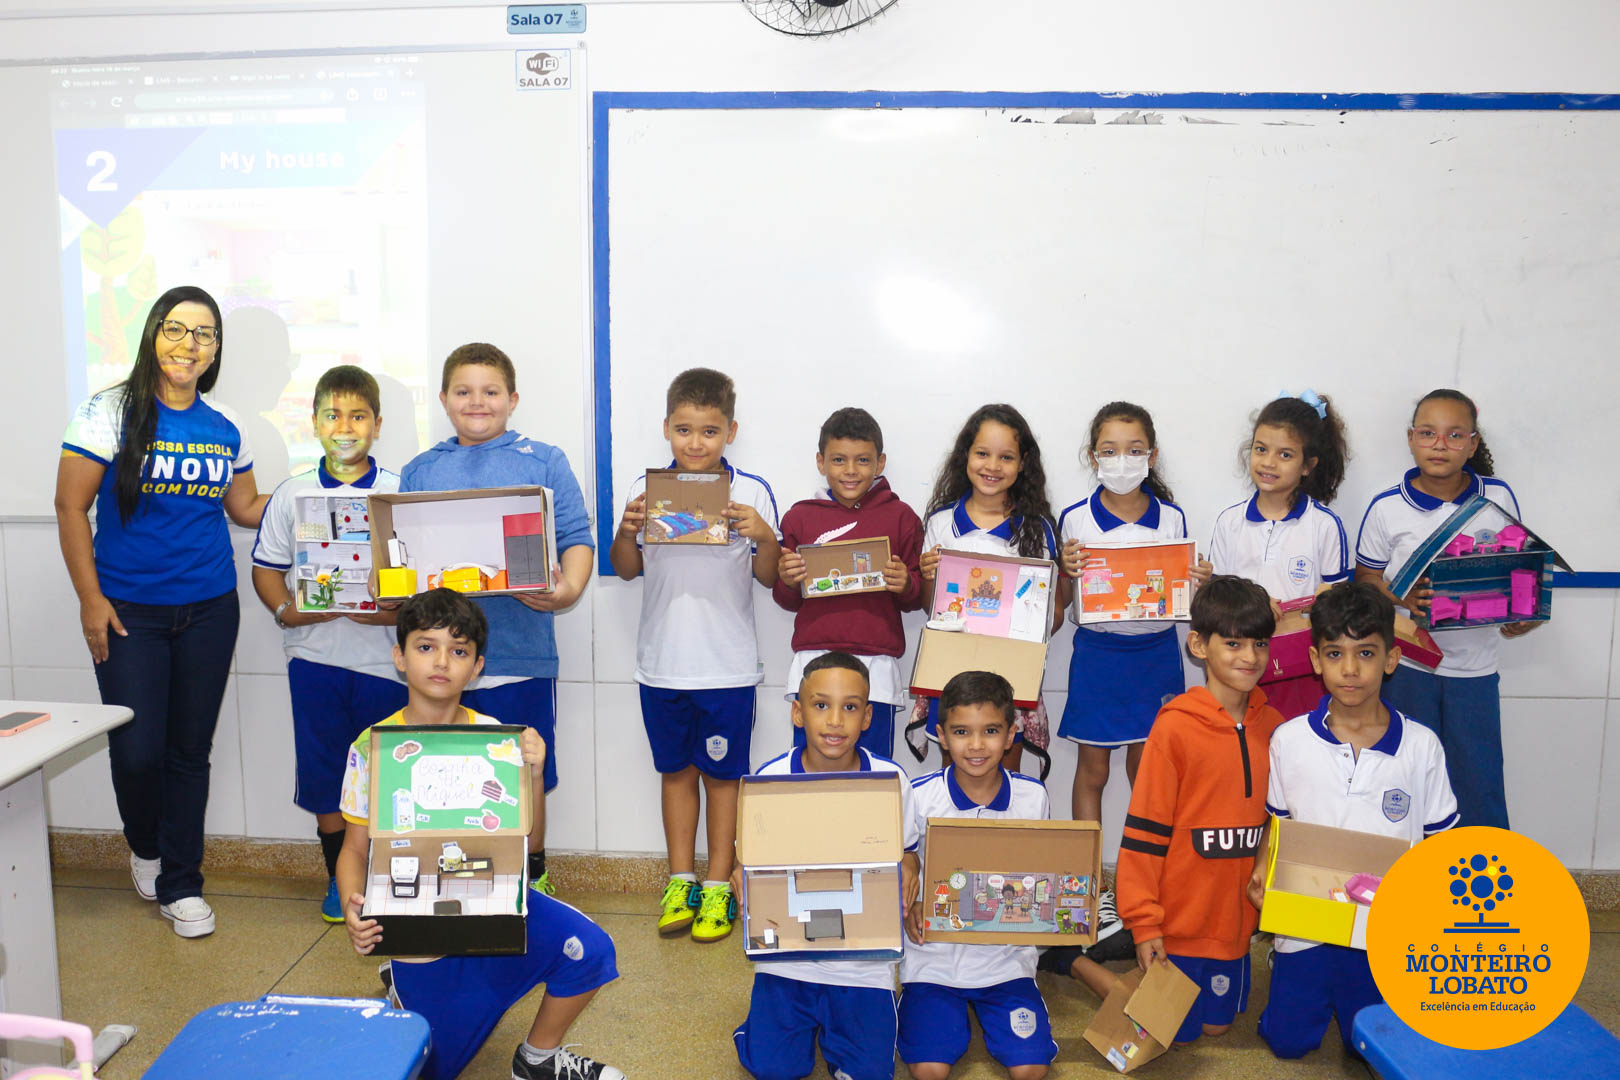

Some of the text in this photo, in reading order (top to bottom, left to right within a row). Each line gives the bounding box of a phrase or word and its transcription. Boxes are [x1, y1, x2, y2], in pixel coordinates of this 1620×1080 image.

[511, 14, 540, 25] Sala
[544, 13, 563, 25] 07
[519, 77, 568, 87] SALA 07
[220, 150, 345, 173] My house
[86, 151, 118, 192] 2
[187, 443, 233, 457] ESCOLA
[141, 483, 182, 495] COM
